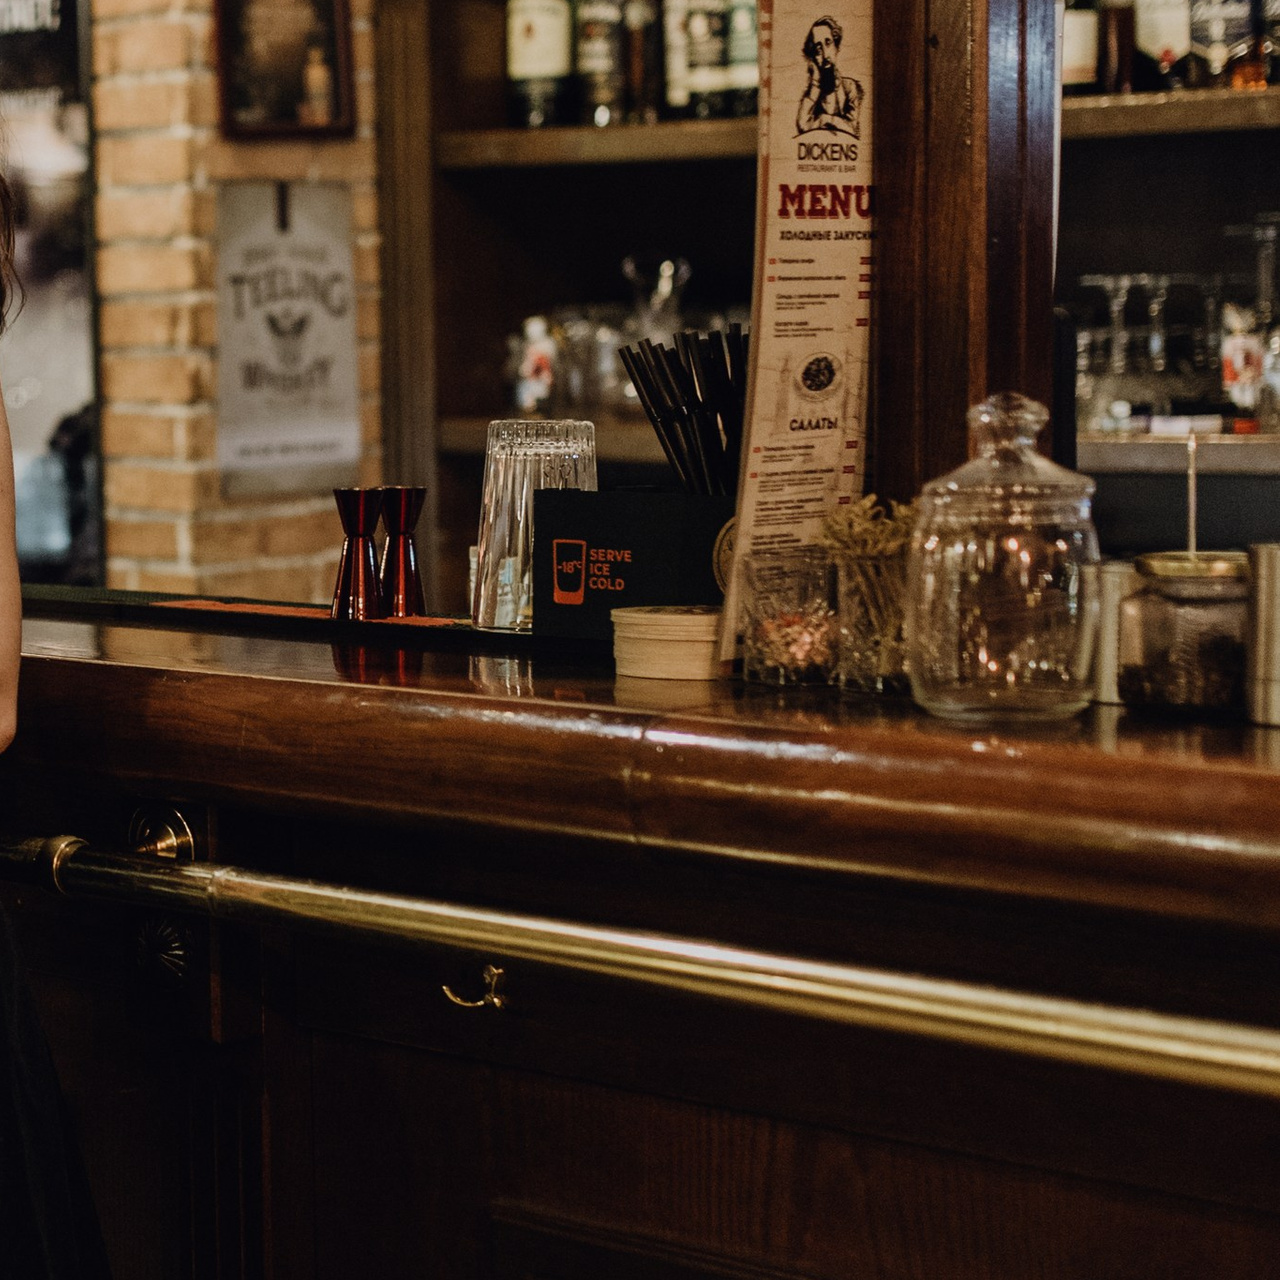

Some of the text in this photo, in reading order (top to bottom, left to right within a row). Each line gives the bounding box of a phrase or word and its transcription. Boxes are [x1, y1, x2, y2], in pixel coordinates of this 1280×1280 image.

[798, 143, 858, 161] DICKENS
[778, 184, 876, 219] MENU
[789, 417, 838, 431] САЛАТЫ
[589, 549, 632, 562] SERVE
[589, 563, 610, 575] ICE
[588, 577, 625, 590] COLD
